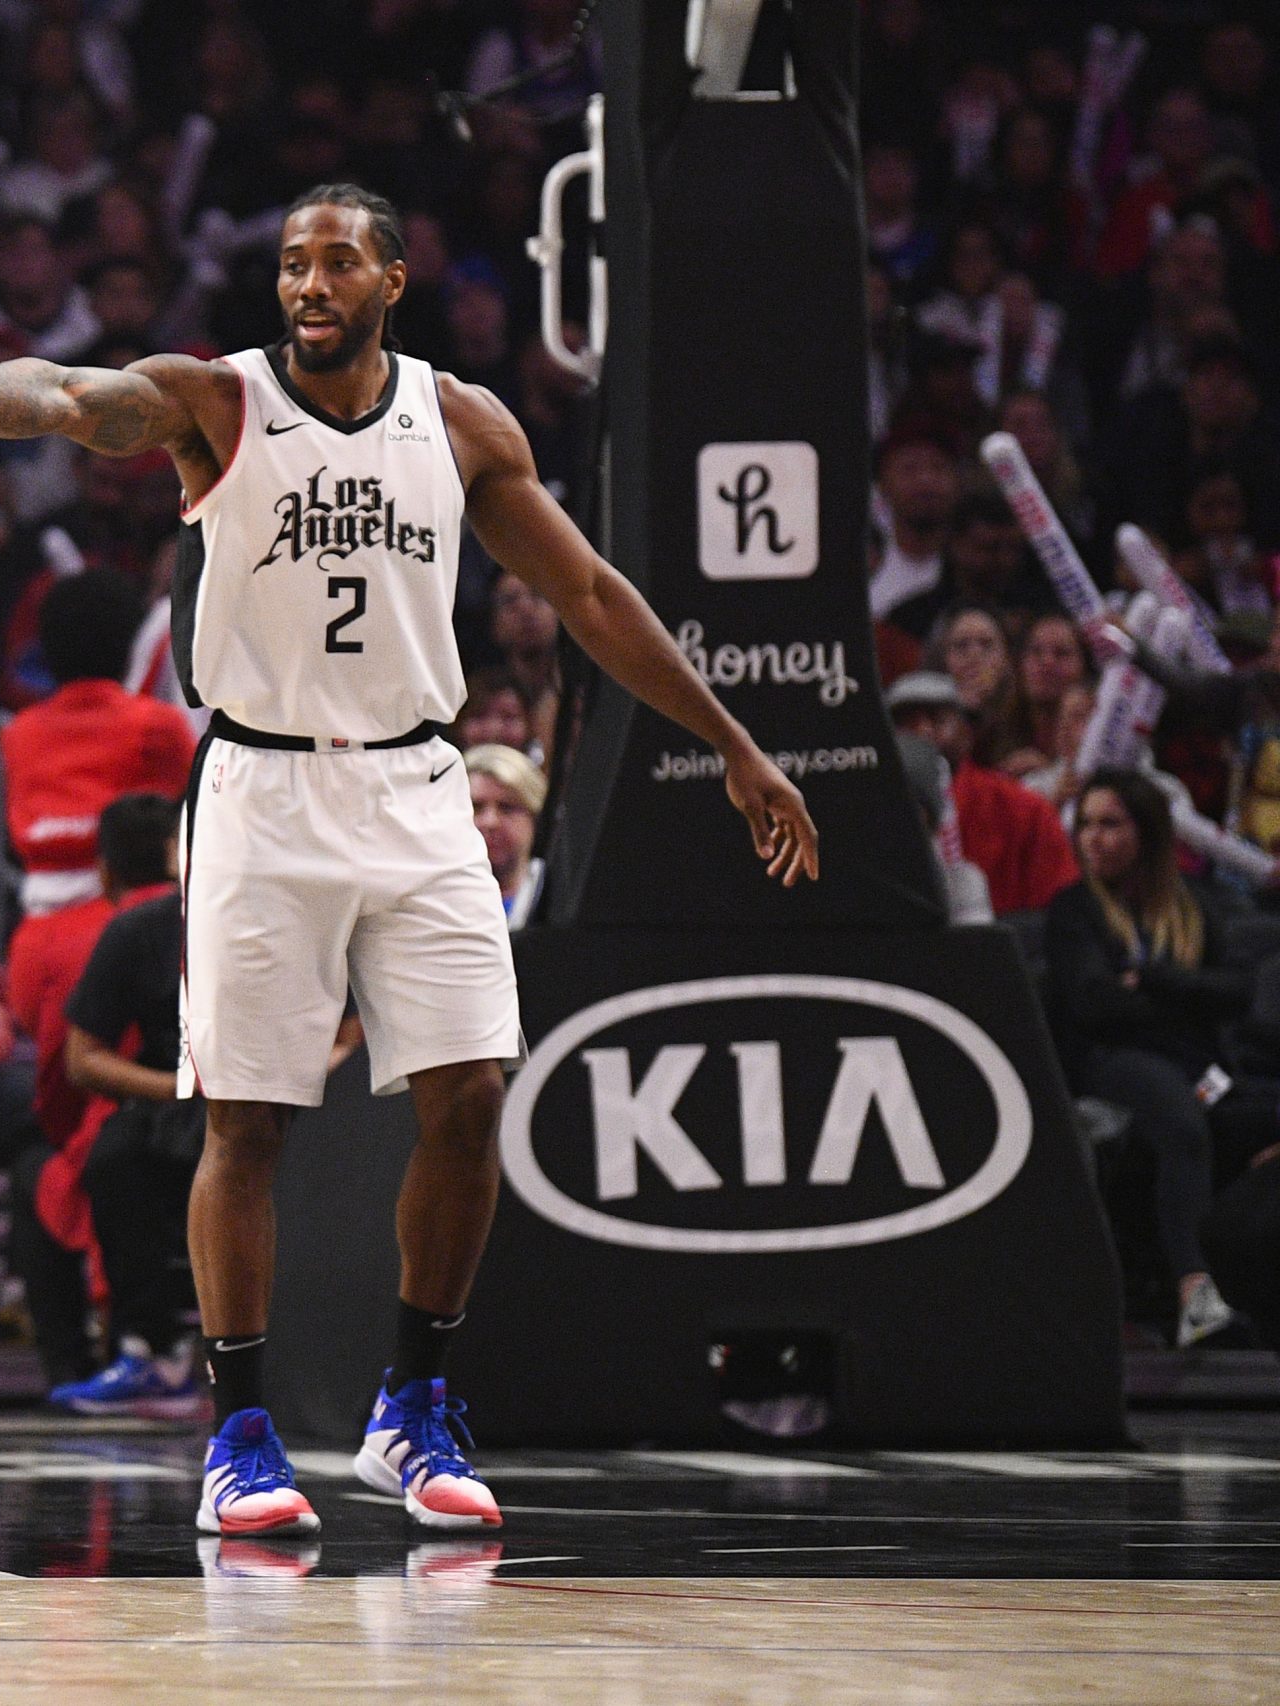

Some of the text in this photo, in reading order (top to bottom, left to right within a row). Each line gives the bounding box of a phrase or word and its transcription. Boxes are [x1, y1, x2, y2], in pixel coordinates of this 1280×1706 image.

[388, 432, 431, 443] bumble
[303, 465, 382, 513] Los
[253, 491, 436, 574] Angeles
[325, 576, 367, 654] 2
[677, 619, 859, 706] honey
[582, 1035, 946, 1200] KIA
